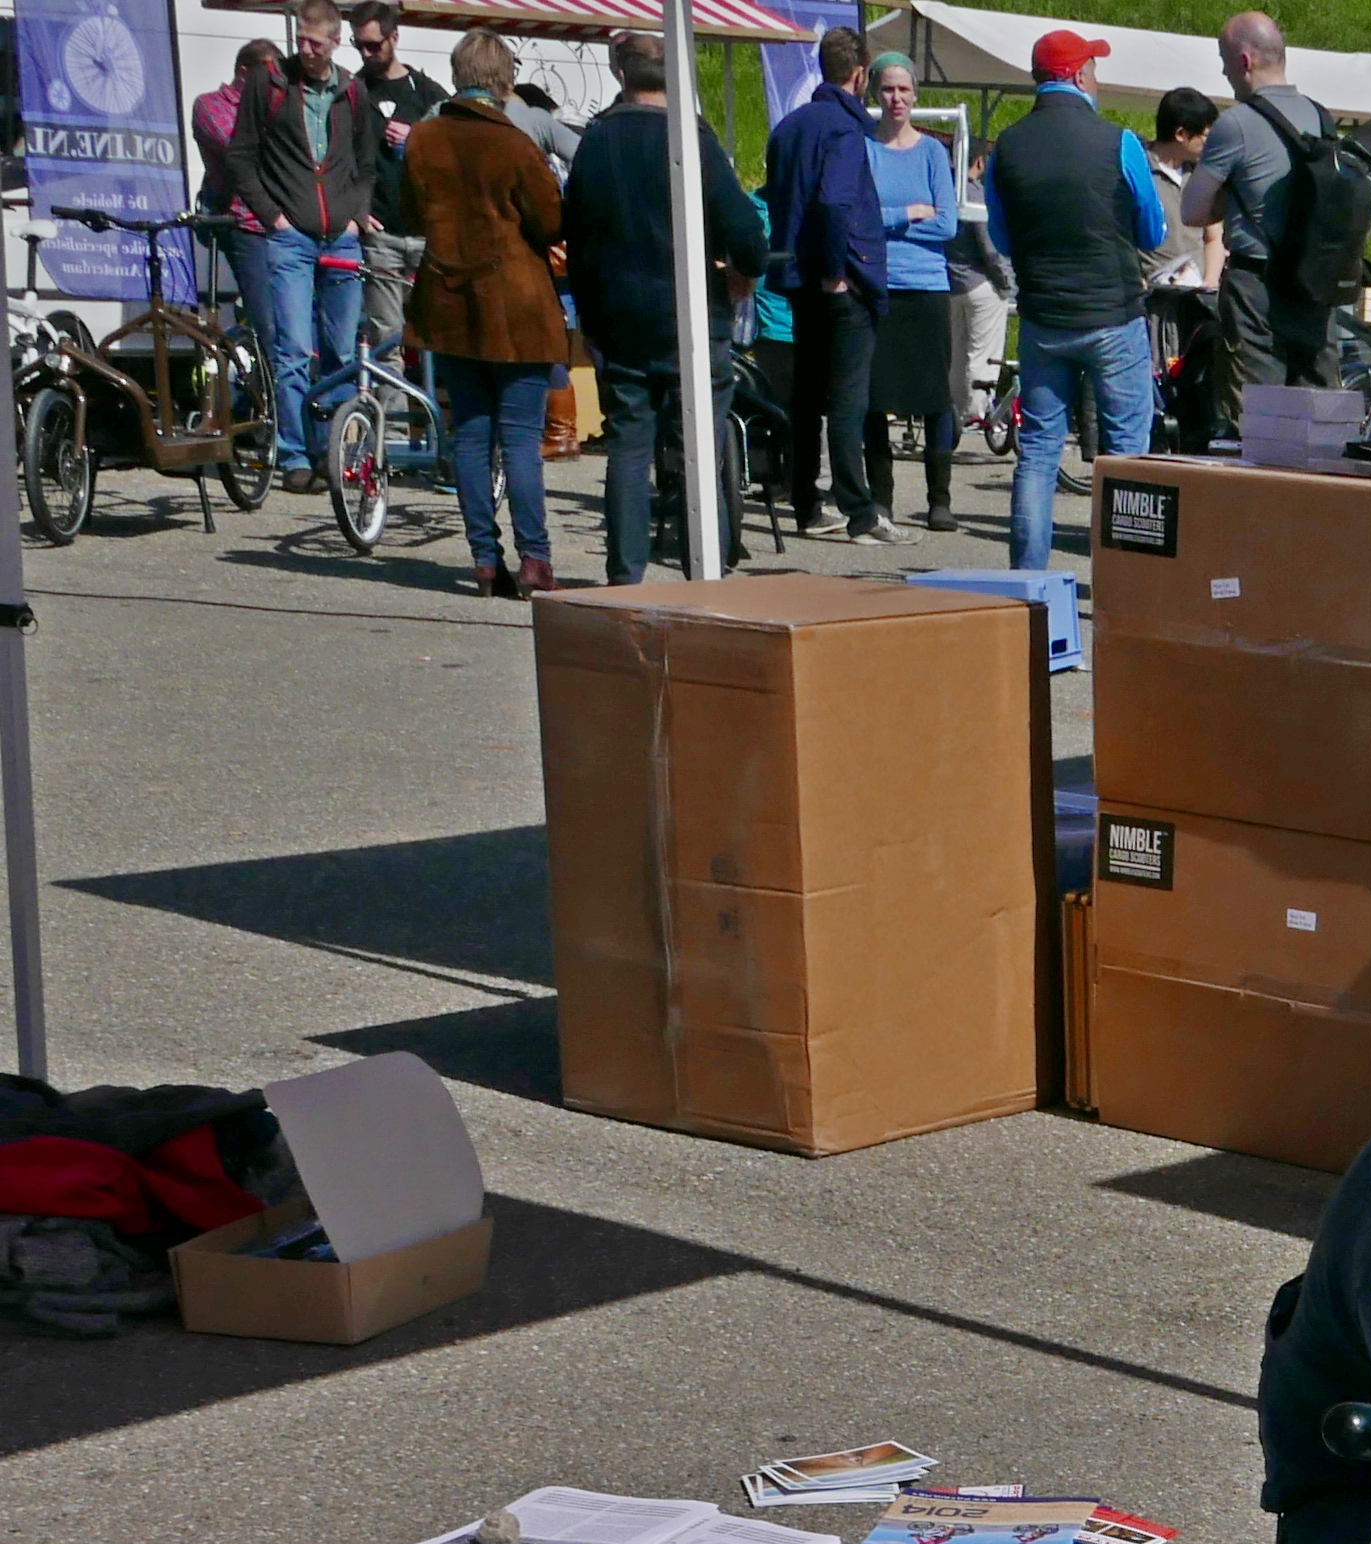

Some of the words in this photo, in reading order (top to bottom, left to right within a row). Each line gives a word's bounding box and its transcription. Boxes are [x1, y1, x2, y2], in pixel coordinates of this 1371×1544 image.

[1113, 488, 1166, 519] NIMBLE
[1109, 824, 1162, 854] NIMBLE
[902, 1503, 989, 1519] 2014
